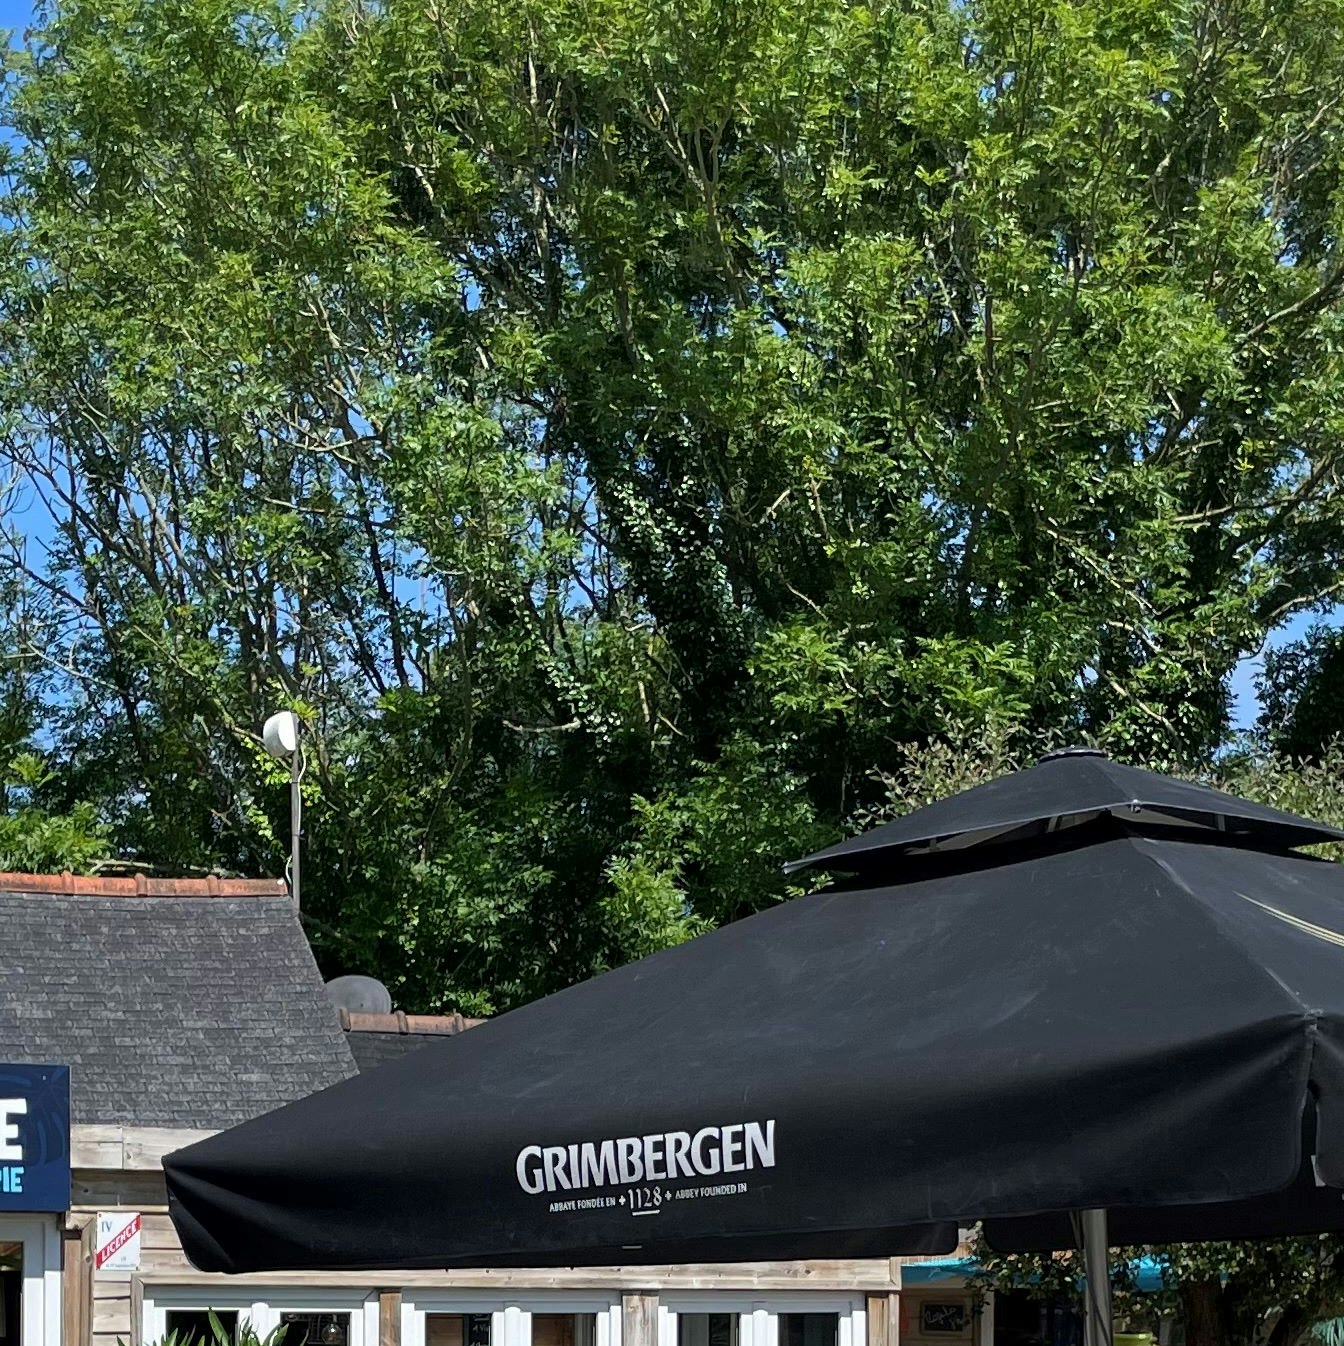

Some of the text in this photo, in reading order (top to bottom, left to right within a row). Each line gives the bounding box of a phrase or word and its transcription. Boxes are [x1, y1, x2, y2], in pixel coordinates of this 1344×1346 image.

[515, 1119, 776, 1195] GRIMBERGEN
[628, 1186, 663, 1209] 1128
[101, 1219, 138, 1262] LICENCE
